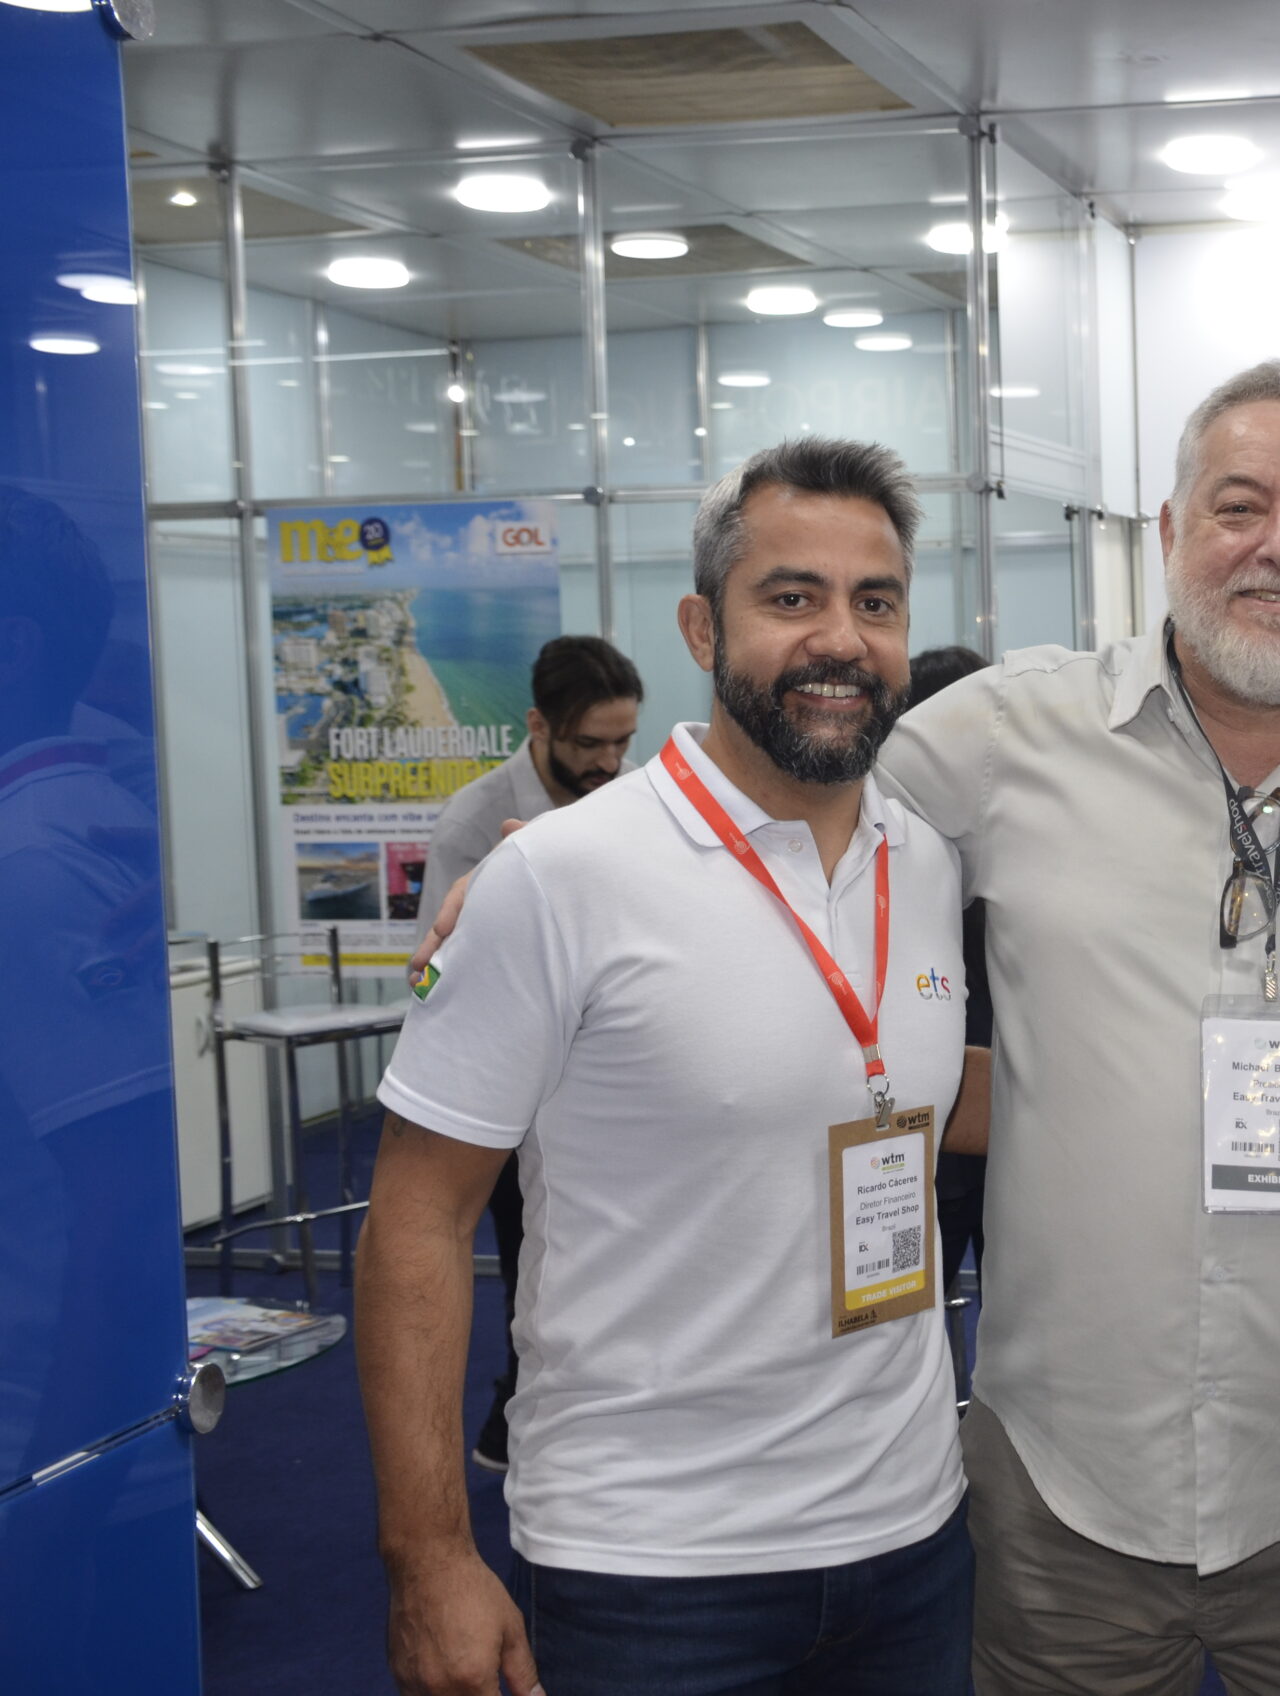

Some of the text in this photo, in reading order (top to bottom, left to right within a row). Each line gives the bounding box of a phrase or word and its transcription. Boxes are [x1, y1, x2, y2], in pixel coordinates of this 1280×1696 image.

[502, 526, 546, 547] GOL
[328, 724, 513, 759] FORT LAUDERDALE
[916, 967, 952, 1000] ets
[907, 1112, 930, 1125] wtm
[881, 1152, 905, 1166] wtm
[857, 1175, 918, 1195] Ricardo Cáceres
[859, 1191, 916, 1211] Diretor Financeiro
[855, 1204, 919, 1226] Easy Travel Shop
[861, 1280, 917, 1302] TRADE VISITOR
